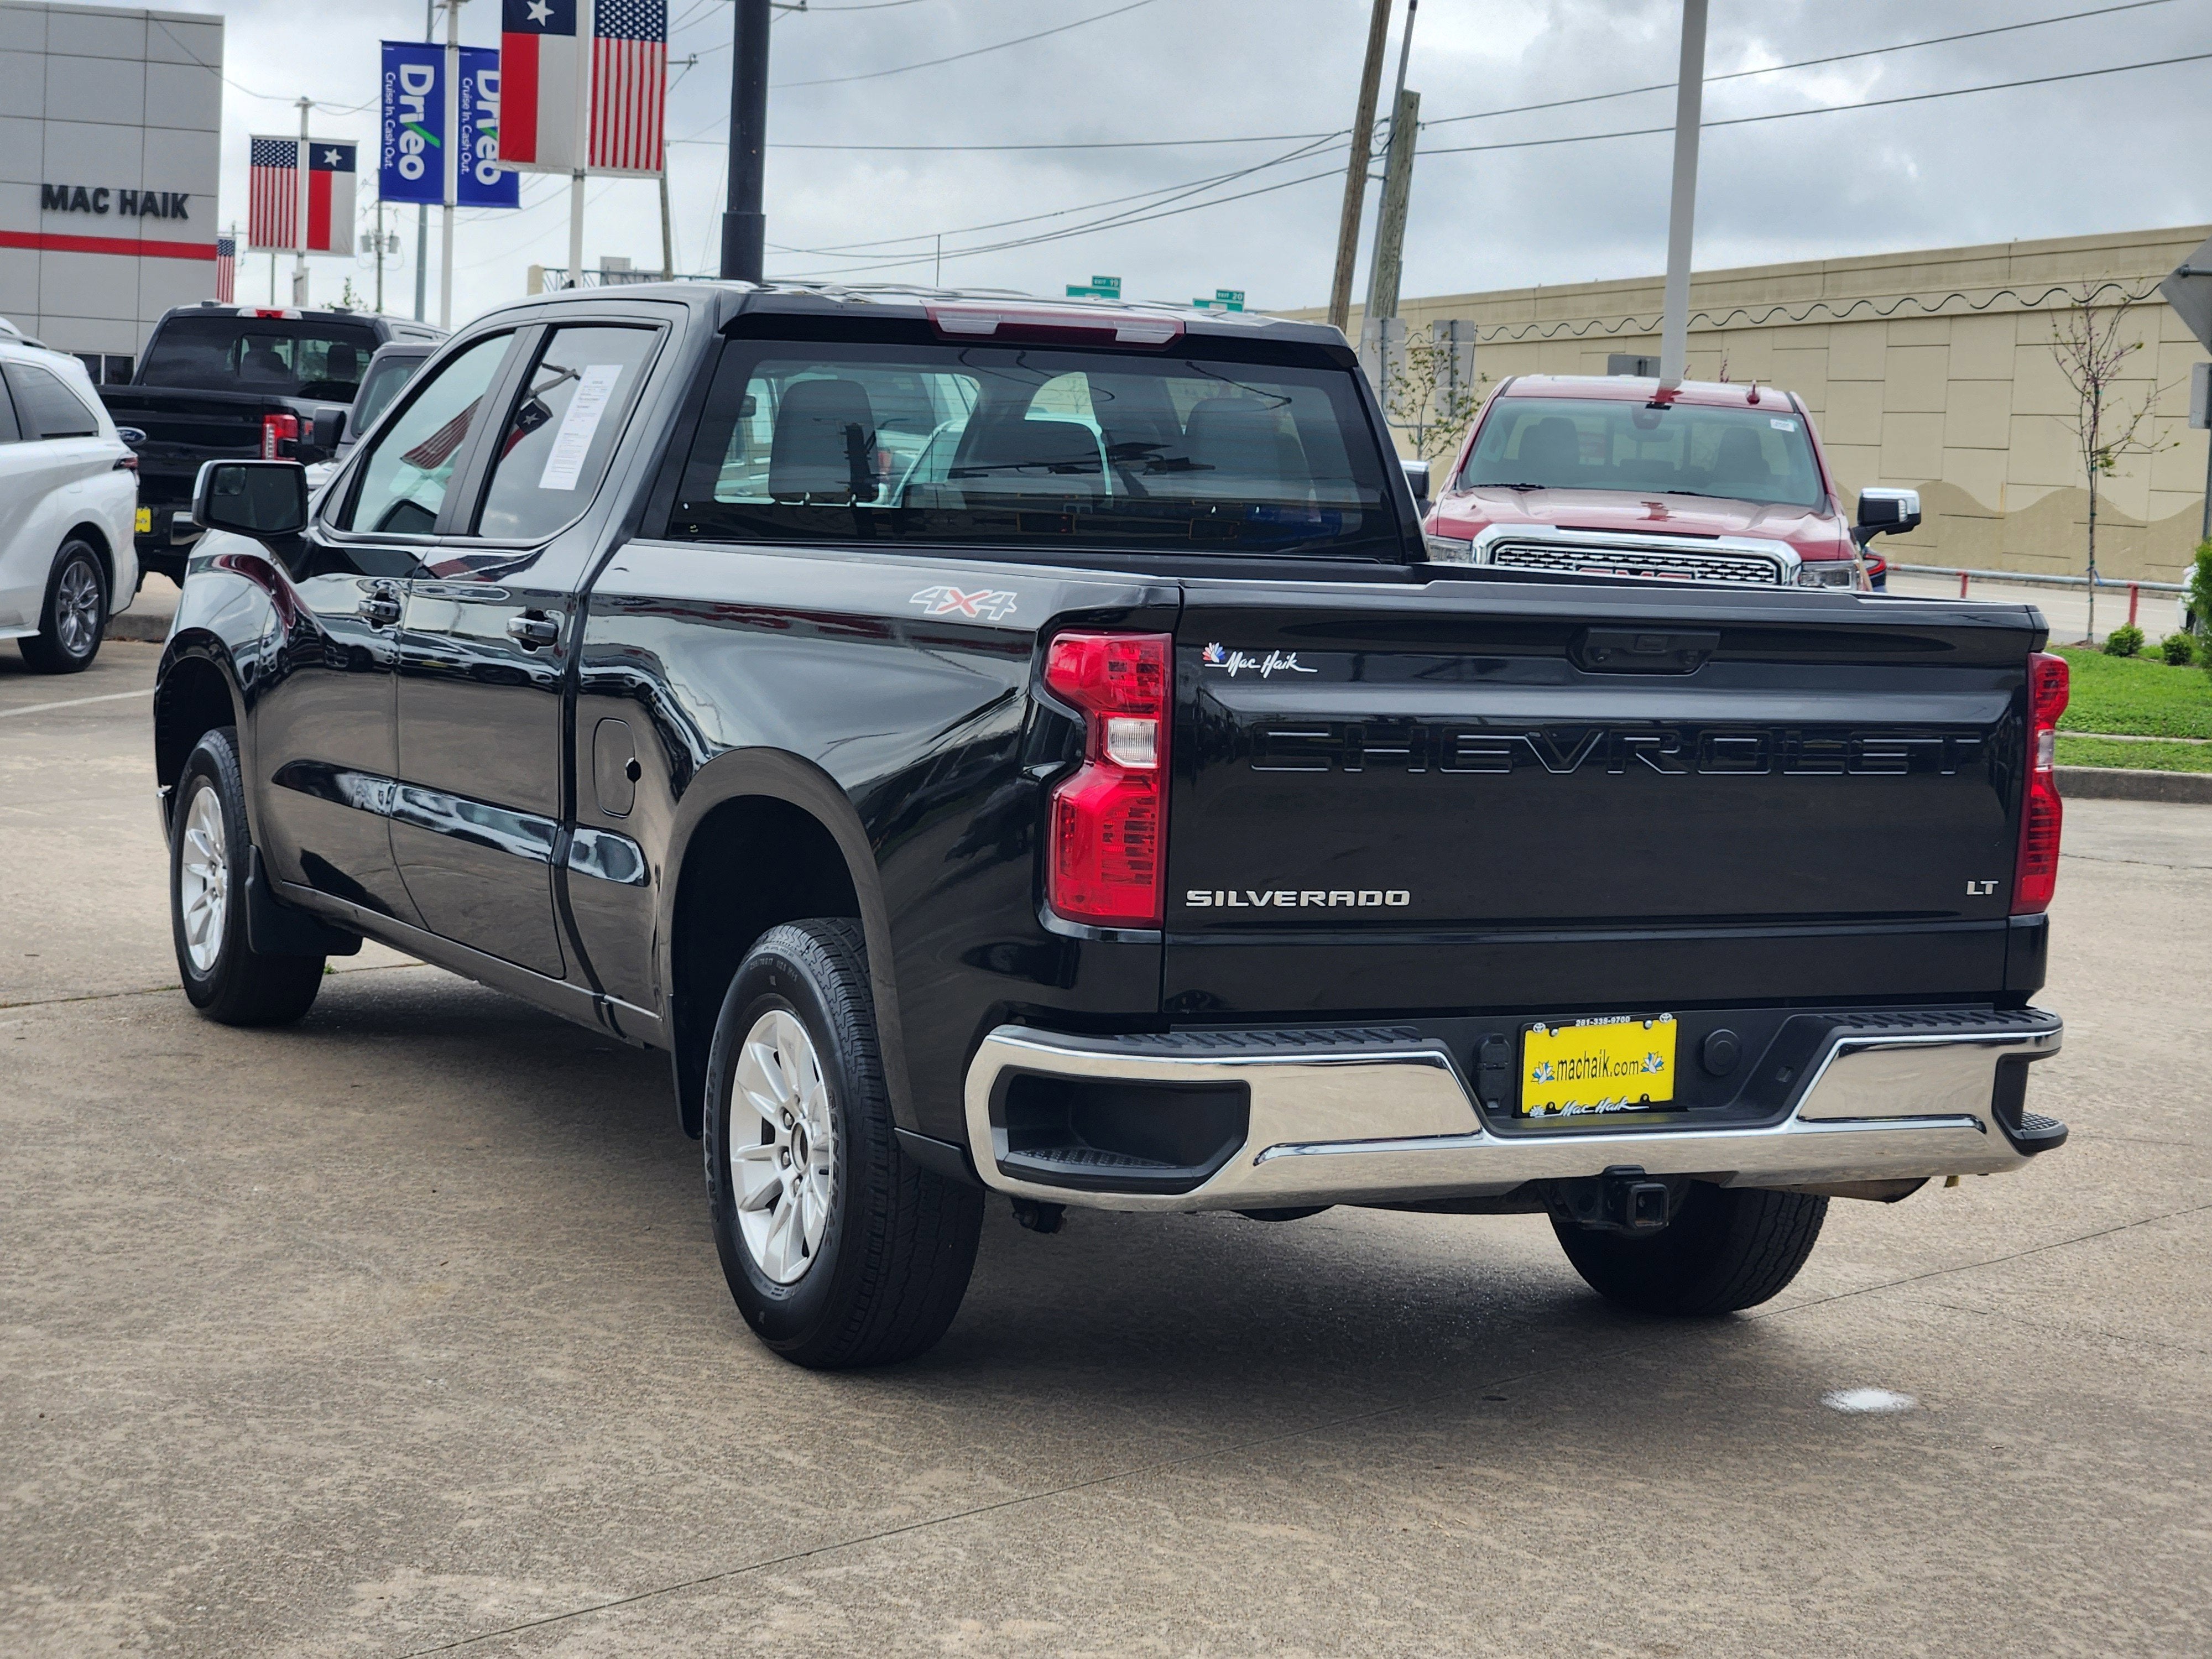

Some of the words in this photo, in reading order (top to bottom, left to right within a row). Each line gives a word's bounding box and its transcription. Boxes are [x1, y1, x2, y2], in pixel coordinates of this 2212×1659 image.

[385, 72, 395, 105] Cruise
[463, 77, 473, 110] Cruise
[385, 120, 395, 145] Cash
[462, 124, 472, 150] Cash
[41, 183, 109, 214] MAC
[119, 189, 189, 220] HAIK
[1232, 292, 1243, 301] 20
[1204, 650, 1261, 678] Mac
[1260, 649, 1318, 679] Haik
[1250, 721, 1983, 776] CHEVROLET
[1185, 890, 1411, 907] SILVERADO
[1966, 880, 1999, 895] LT
[1557, 1049, 1640, 1082] machaik.com
[1535, 1099, 1595, 1118] Mac
